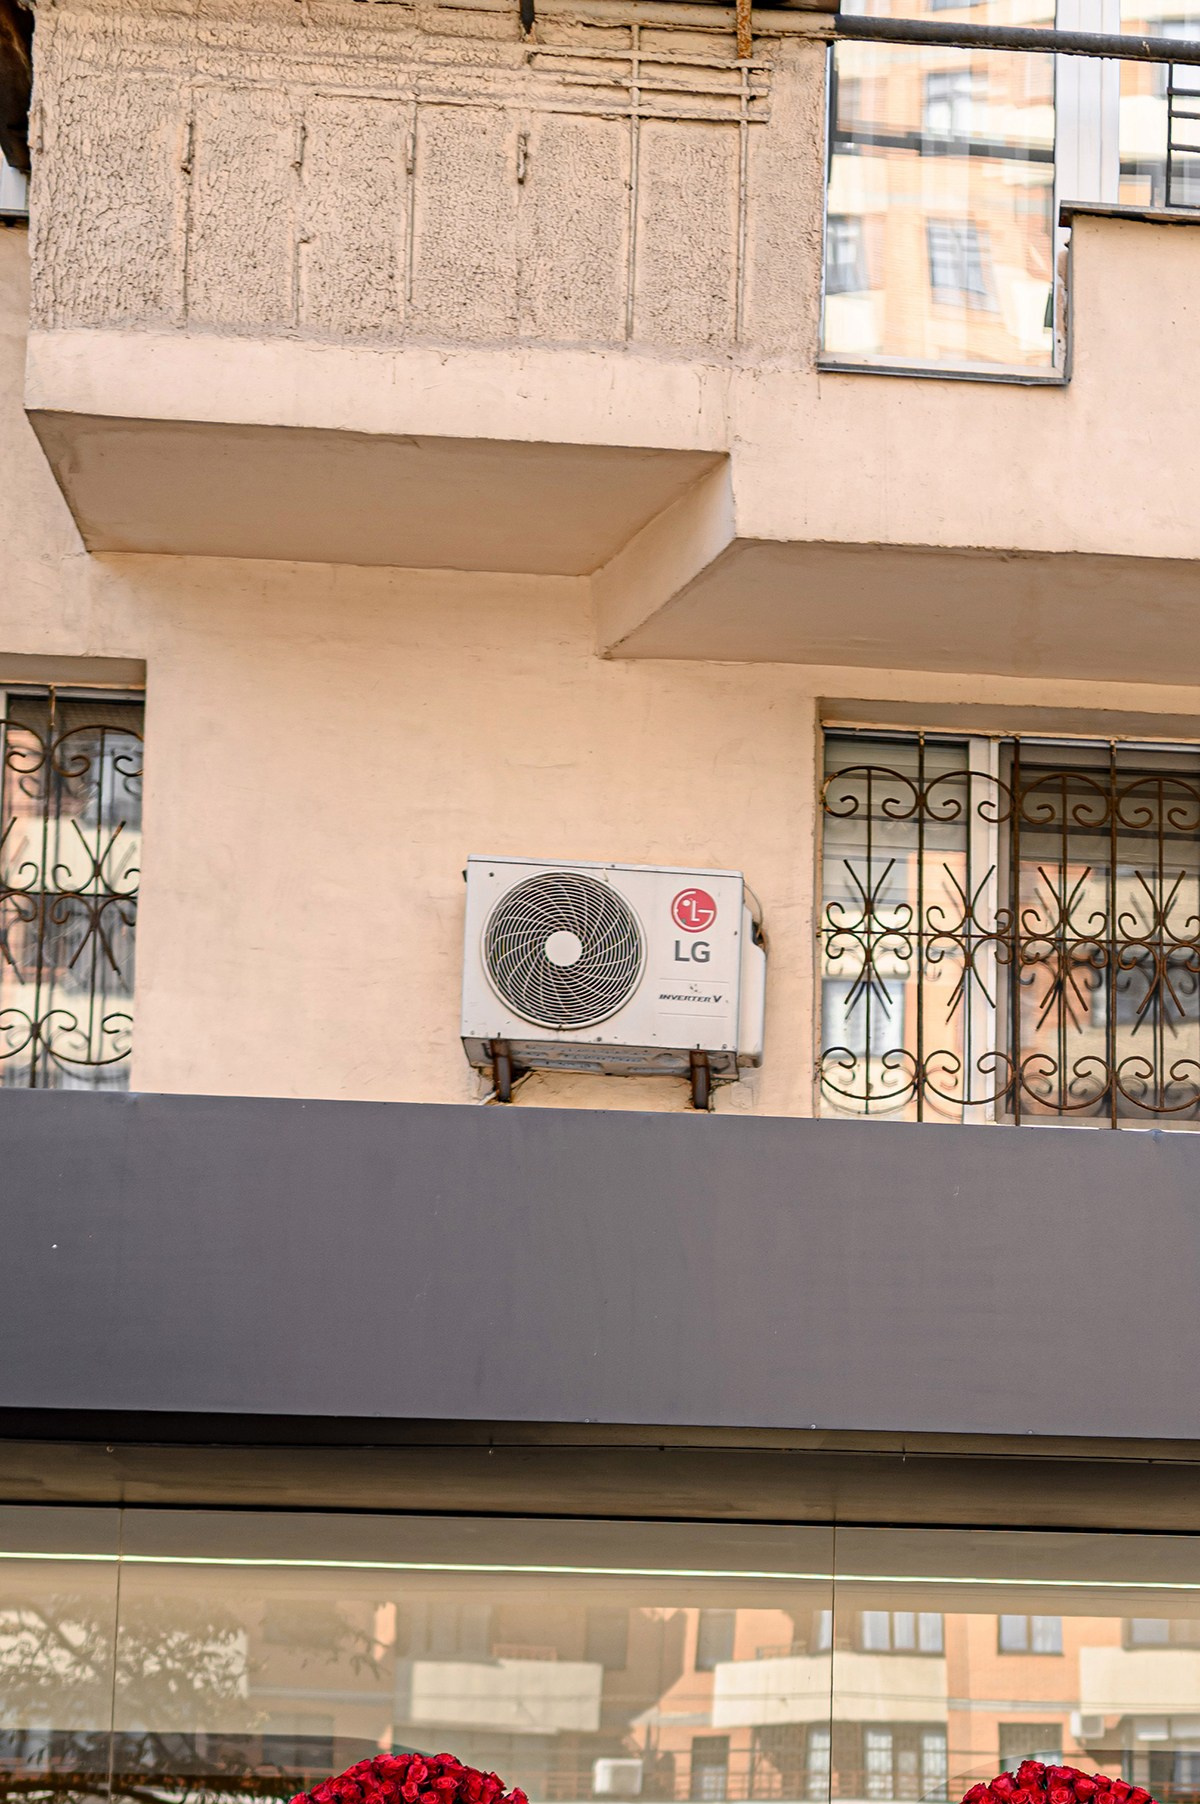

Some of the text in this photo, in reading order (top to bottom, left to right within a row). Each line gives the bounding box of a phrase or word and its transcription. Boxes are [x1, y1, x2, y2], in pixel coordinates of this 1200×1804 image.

[674, 940, 711, 963] LG
[659, 994, 722, 1003] INVERTER V
